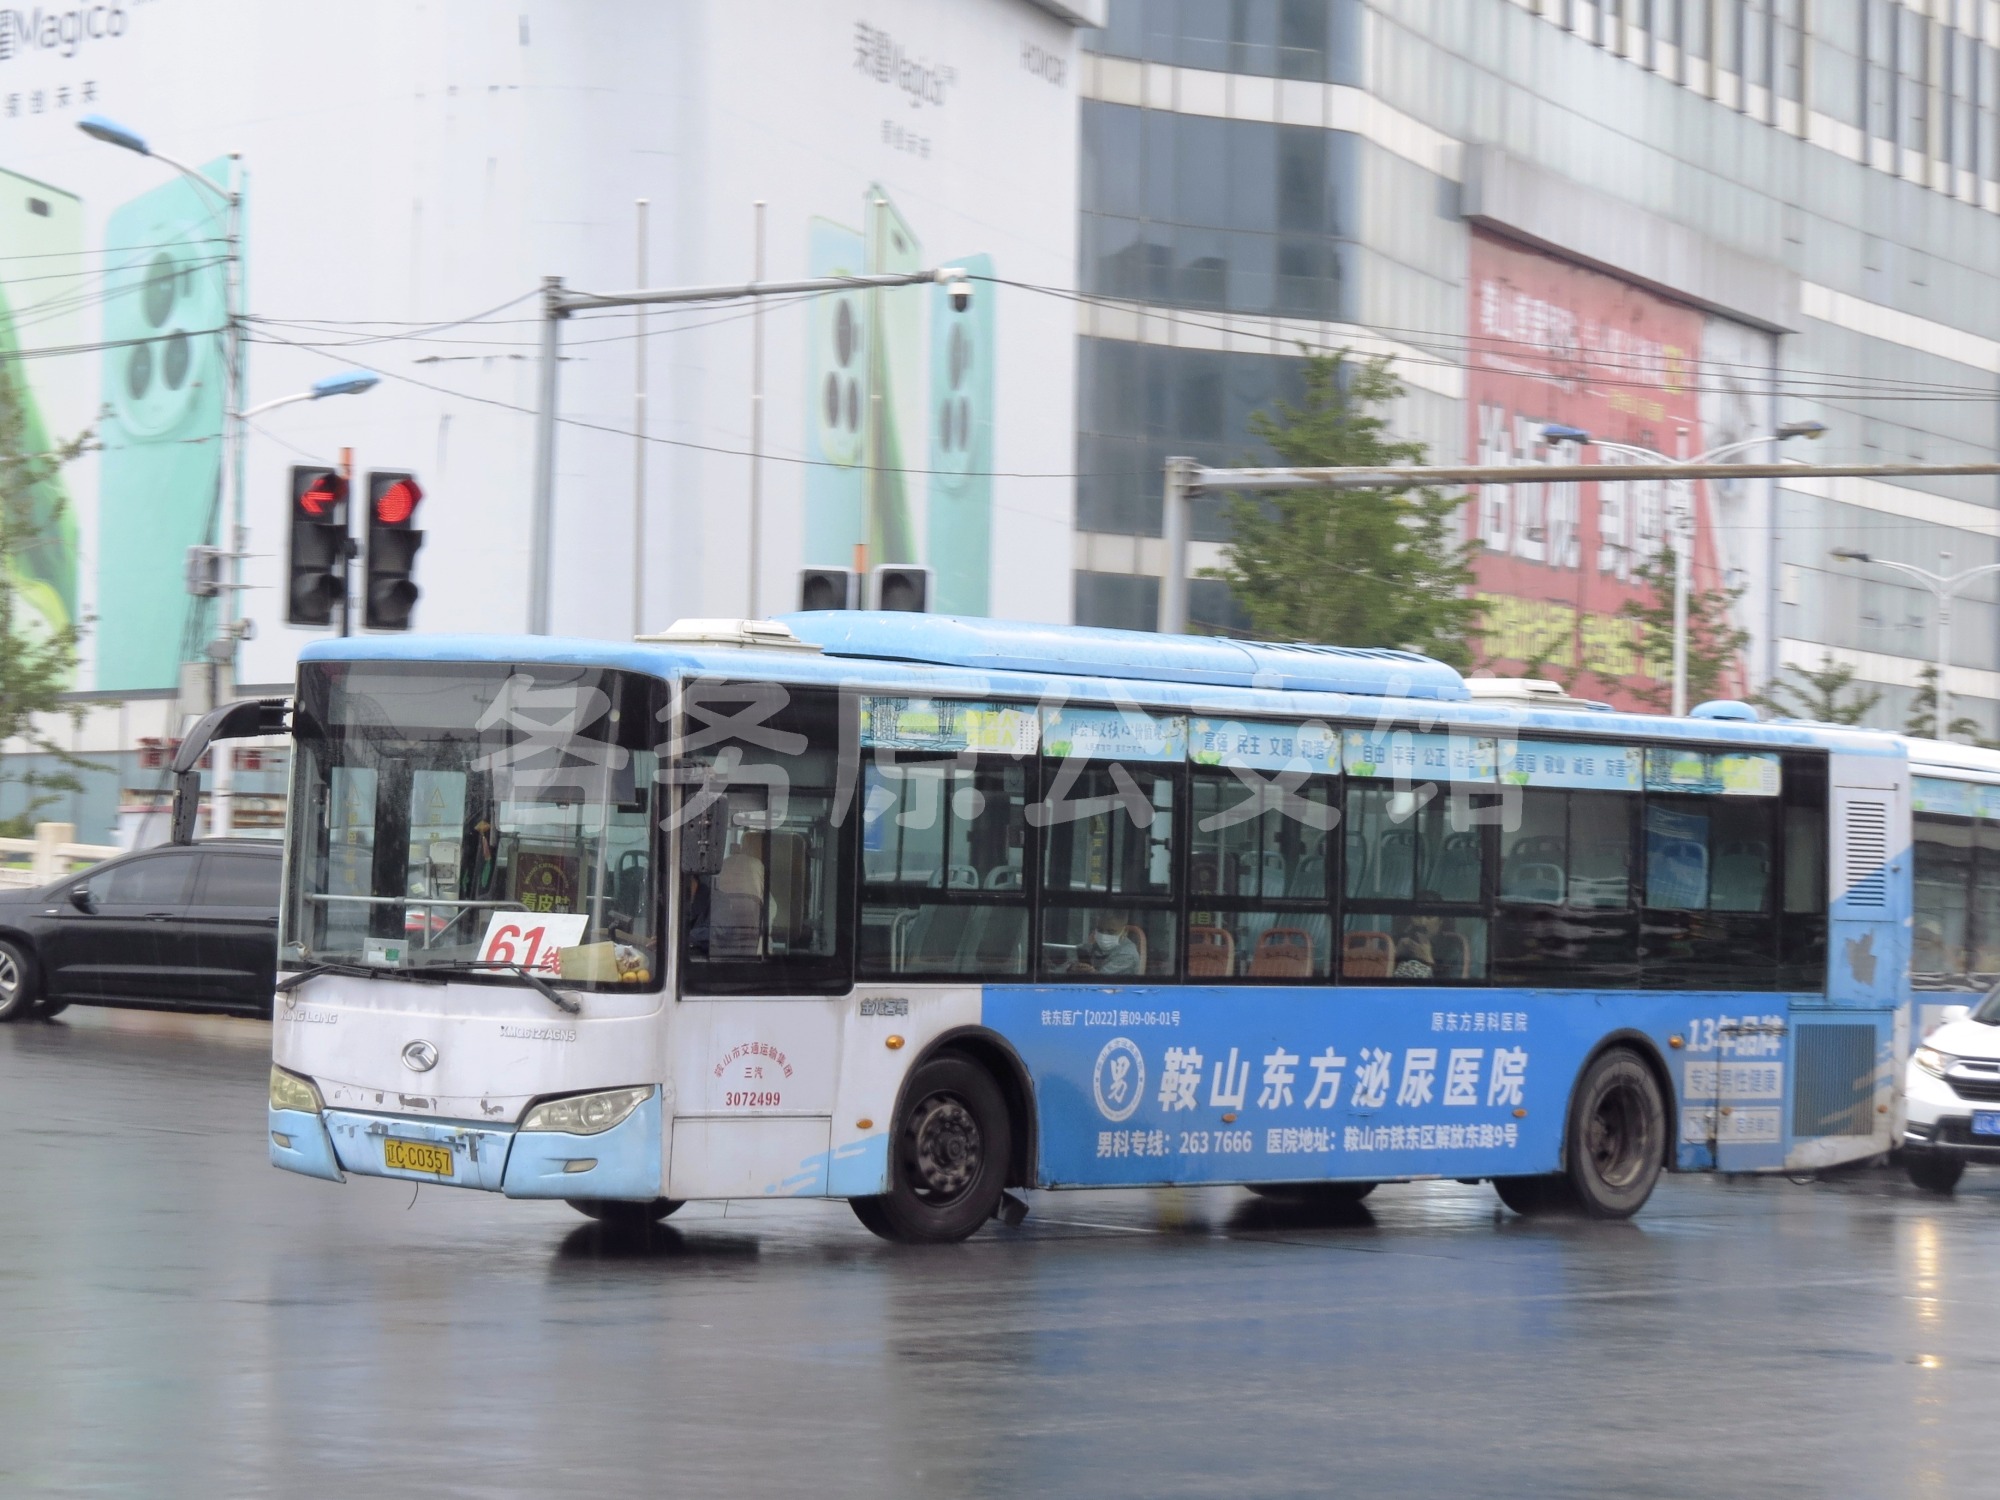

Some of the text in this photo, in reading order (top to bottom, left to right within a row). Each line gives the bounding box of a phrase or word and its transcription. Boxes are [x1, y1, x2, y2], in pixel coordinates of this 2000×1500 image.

[1204, 731, 1325, 760] 富强 民主 文明 和谐
[1362, 745, 1386, 765] 自由
[1393, 745, 1416, 766] 平等
[1424, 747, 1446, 767] 公正
[1514, 753, 1627, 778] 爱国 敬业 诚信 友善
[281, 1010, 338, 1024] KING LONG
[1431, 1012, 1529, 1032] 原东方男科医院
[744, 1066, 763, 1079] 三汽
[1158, 1046, 1528, 1112] 鞍山东方泌尿医院
[725, 1091, 781, 1106] 3072499
[1179, 1131, 1209, 1154] 263
[1214, 1131, 1253, 1153] 7666
